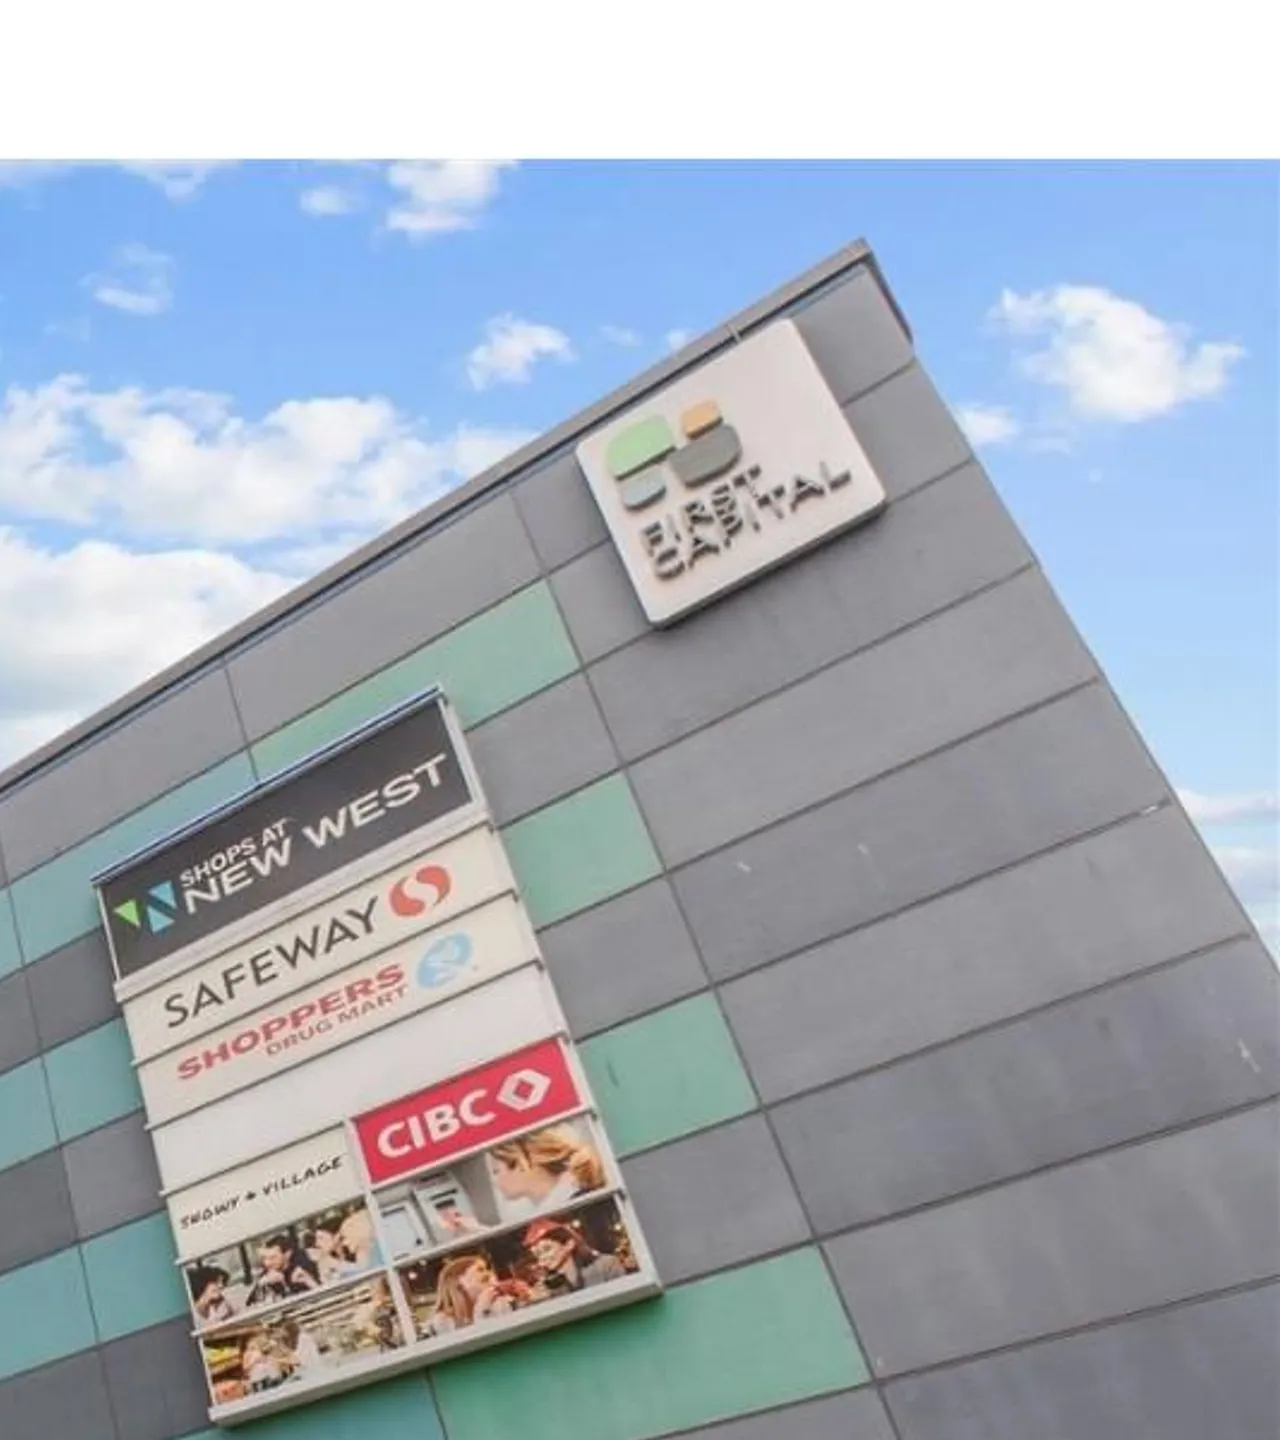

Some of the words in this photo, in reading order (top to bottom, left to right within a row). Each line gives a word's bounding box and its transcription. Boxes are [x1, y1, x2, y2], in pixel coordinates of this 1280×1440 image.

[641, 464, 763, 556] FIRST
[653, 460, 852, 581] CAPITAL
[179, 836, 257, 887] SHOPS
[261, 817, 289, 847] AT
[183, 836, 292, 914] NEW
[302, 753, 446, 849] WEST
[164, 895, 379, 1028] SAFEWAY
[177, 963, 406, 1080] SHOPPERS
[265, 1019, 334, 1057] DRUG
[338, 985, 408, 1024] MART
[377, 1089, 497, 1158] CIBC
[262, 1155, 344, 1197] VILLAGE
